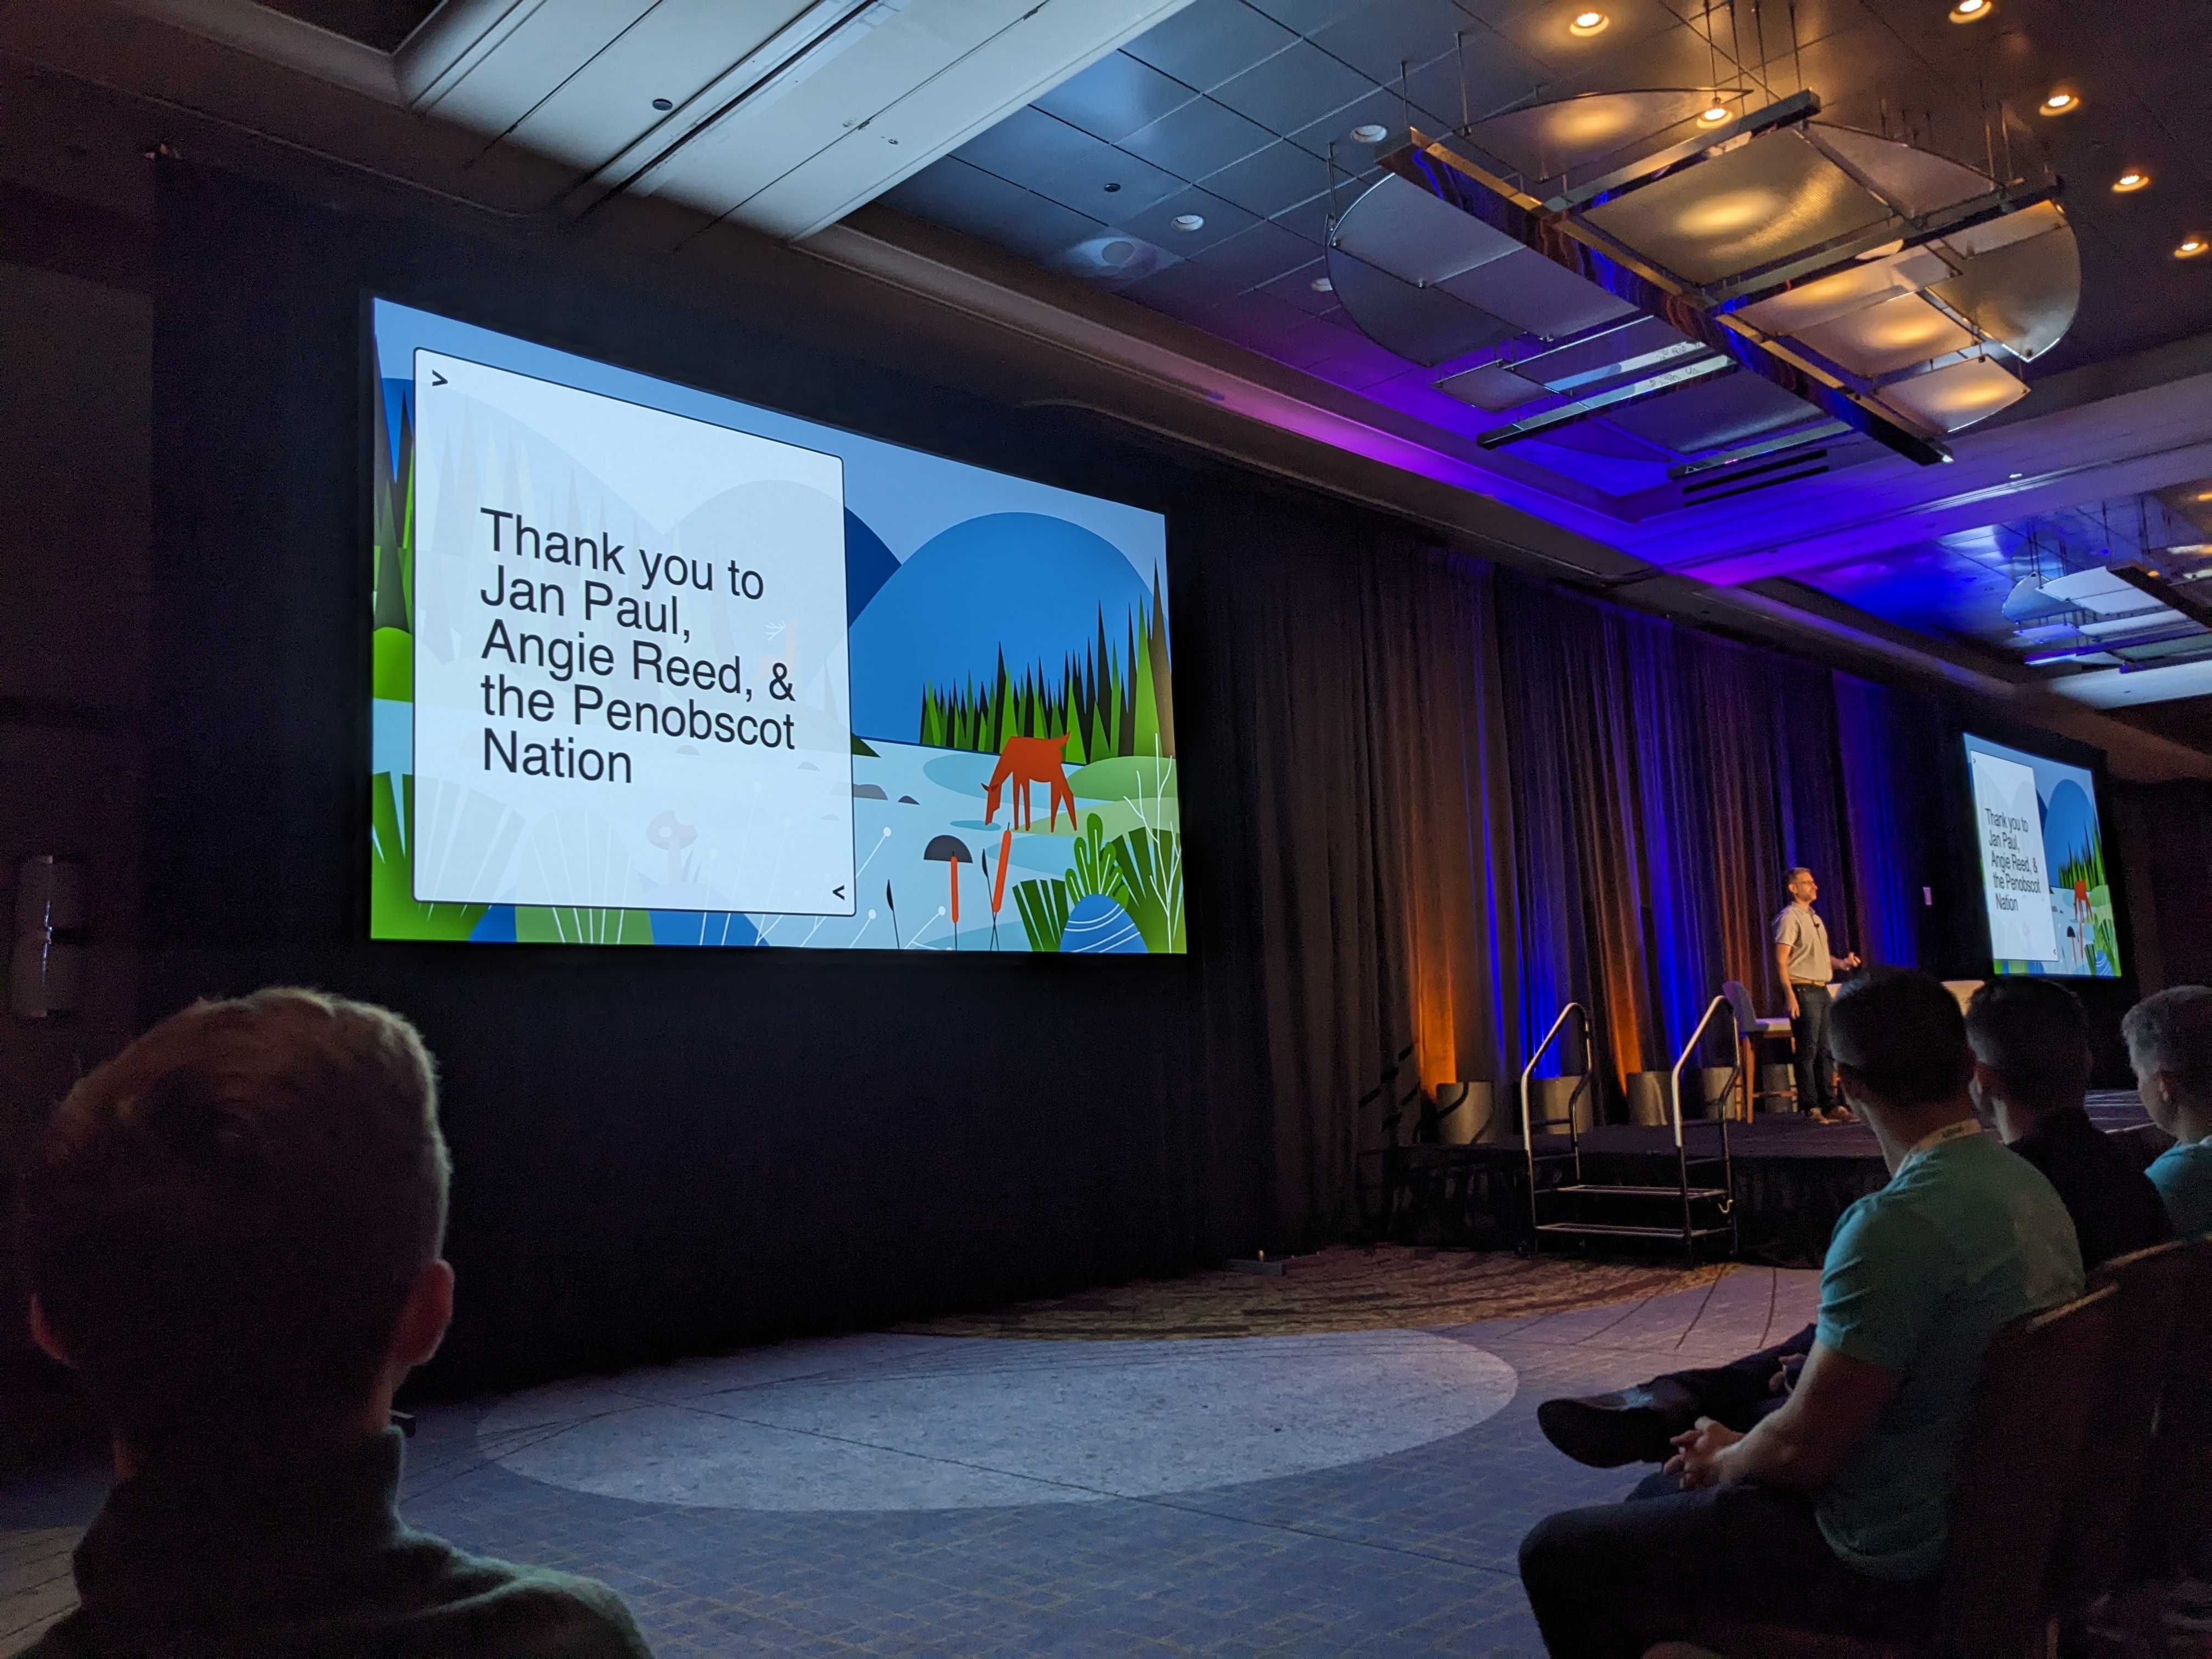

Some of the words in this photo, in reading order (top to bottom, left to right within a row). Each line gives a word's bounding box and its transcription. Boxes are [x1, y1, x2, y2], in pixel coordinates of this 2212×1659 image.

[481, 507, 625, 575] Thank
[639, 549, 713, 590] you
[727, 560, 764, 600] to
[481, 565, 564, 616] Jan
[585, 580, 690, 644] Paul,
[481, 618, 614, 681] Angie
[633, 640, 752, 703] Reed,
[769, 662, 796, 702] &
[481, 675, 554, 722] the
[574, 684, 795, 750] Penobscot
[484, 727, 631, 783] Nation
[1985, 808, 2008, 828] Thank
[2008, 817, 2021, 833] you
[2021, 817, 2029, 832] to
[1989, 830, 2001, 847] Jan
[2002, 832, 2020, 853] Paul,
[1991, 850, 2011, 873] Angie
[2012, 854, 2032, 874] Reed,
[2033, 857, 2038, 873] &
[1993, 872, 2005, 889] the
[2005, 873, 2041, 894] Penobscot
[1995, 893, 2019, 911] Nation
